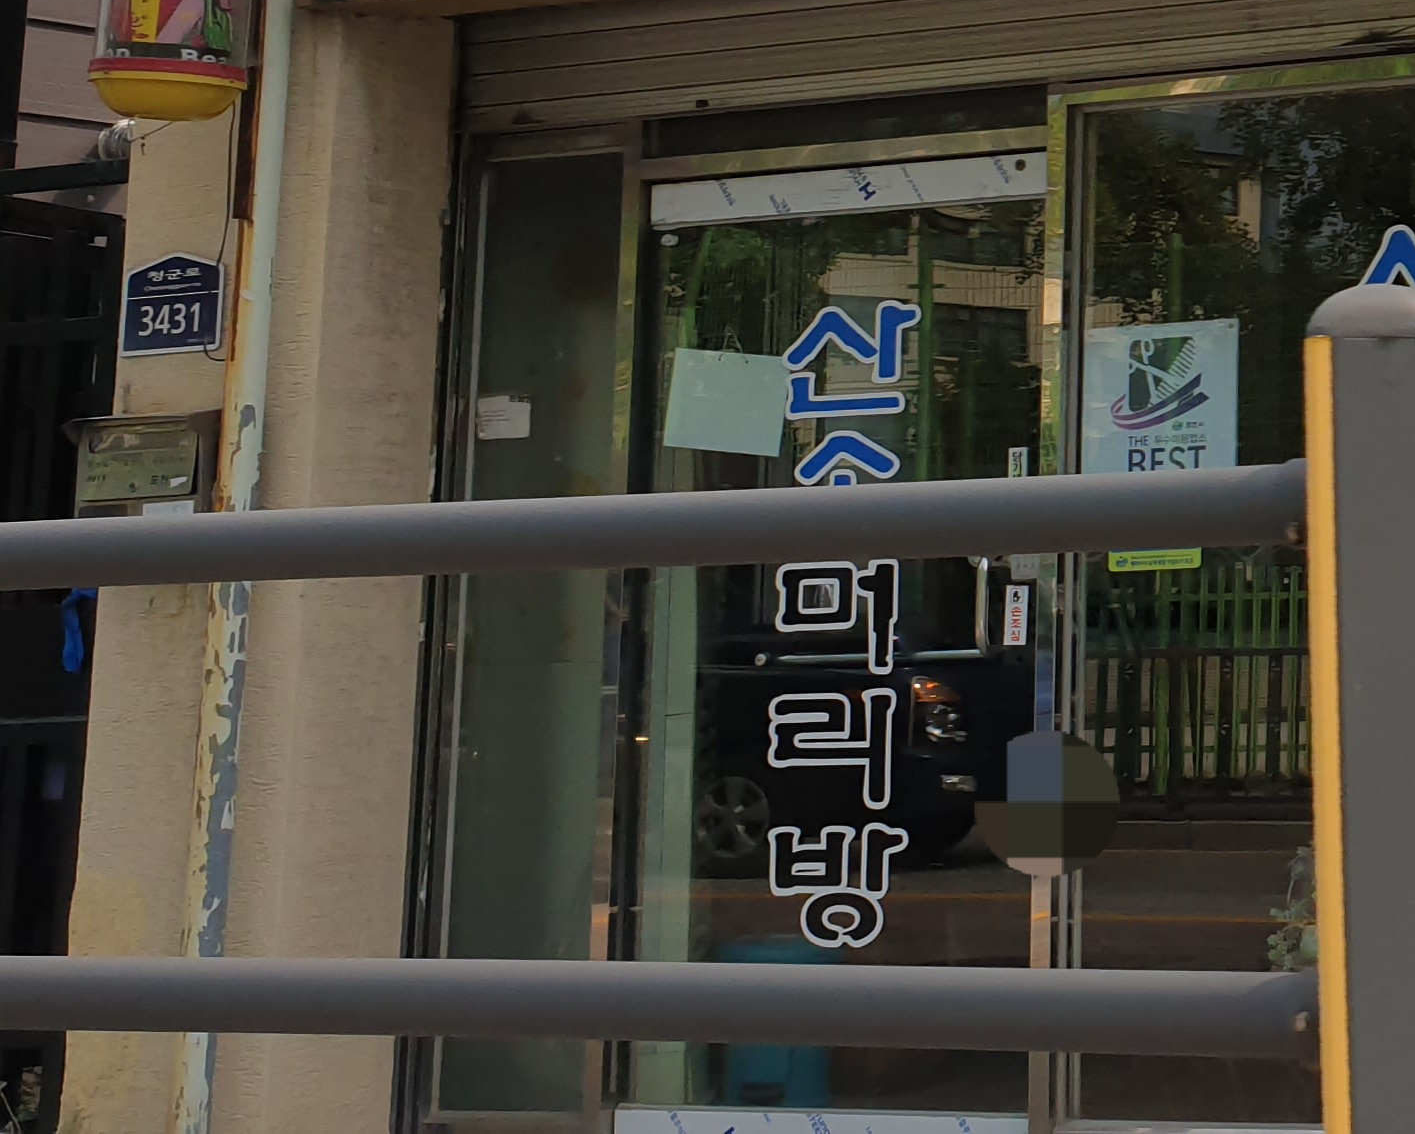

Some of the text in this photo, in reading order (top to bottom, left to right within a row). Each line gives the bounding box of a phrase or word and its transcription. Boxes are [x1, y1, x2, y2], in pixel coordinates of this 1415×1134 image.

[138, 302, 201, 336] 3431
[1128, 435, 1149, 447] THE
[1127, 444, 1207, 472] BEST
[1010, 605, 1022, 642] 손조심
